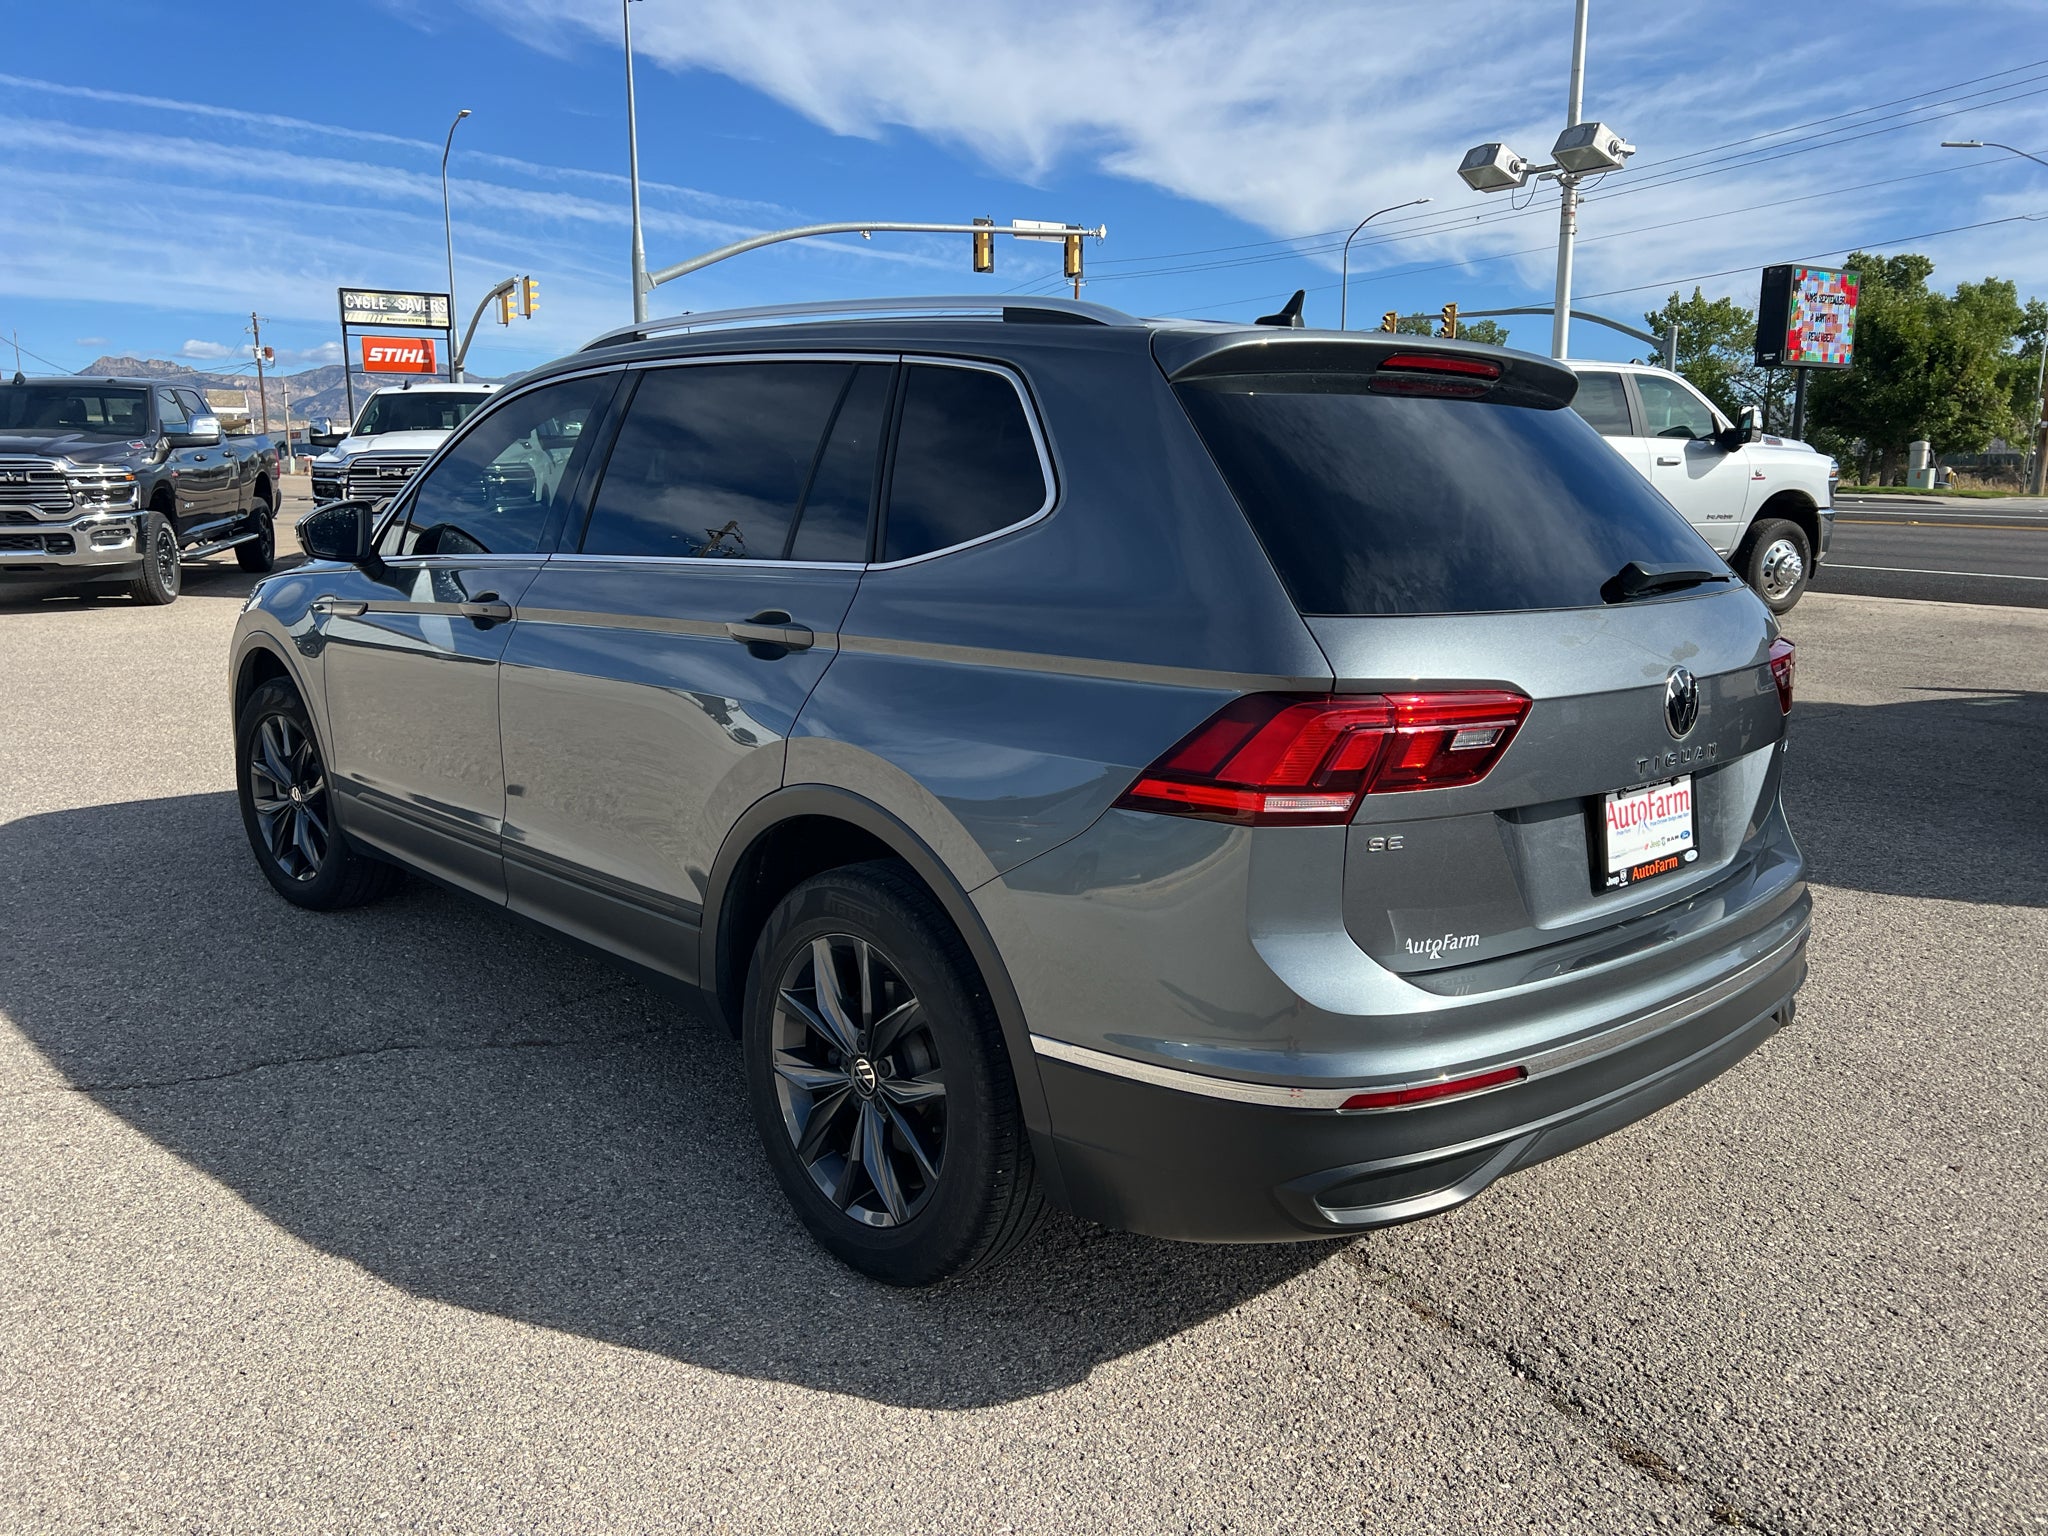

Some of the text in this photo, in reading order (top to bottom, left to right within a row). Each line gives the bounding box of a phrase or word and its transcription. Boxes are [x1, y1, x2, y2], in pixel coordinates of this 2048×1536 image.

[345, 294, 447, 313] CYCLE SAVERS
[367, 347, 430, 364] STIHL
[1636, 742, 1718, 774] TIGUAN
[1606, 790, 1690, 830] AutoFarm
[1367, 835, 1404, 852] SE
[1631, 856, 1679, 882] AutoFarm
[1405, 933, 1480, 956] AutoFarm
